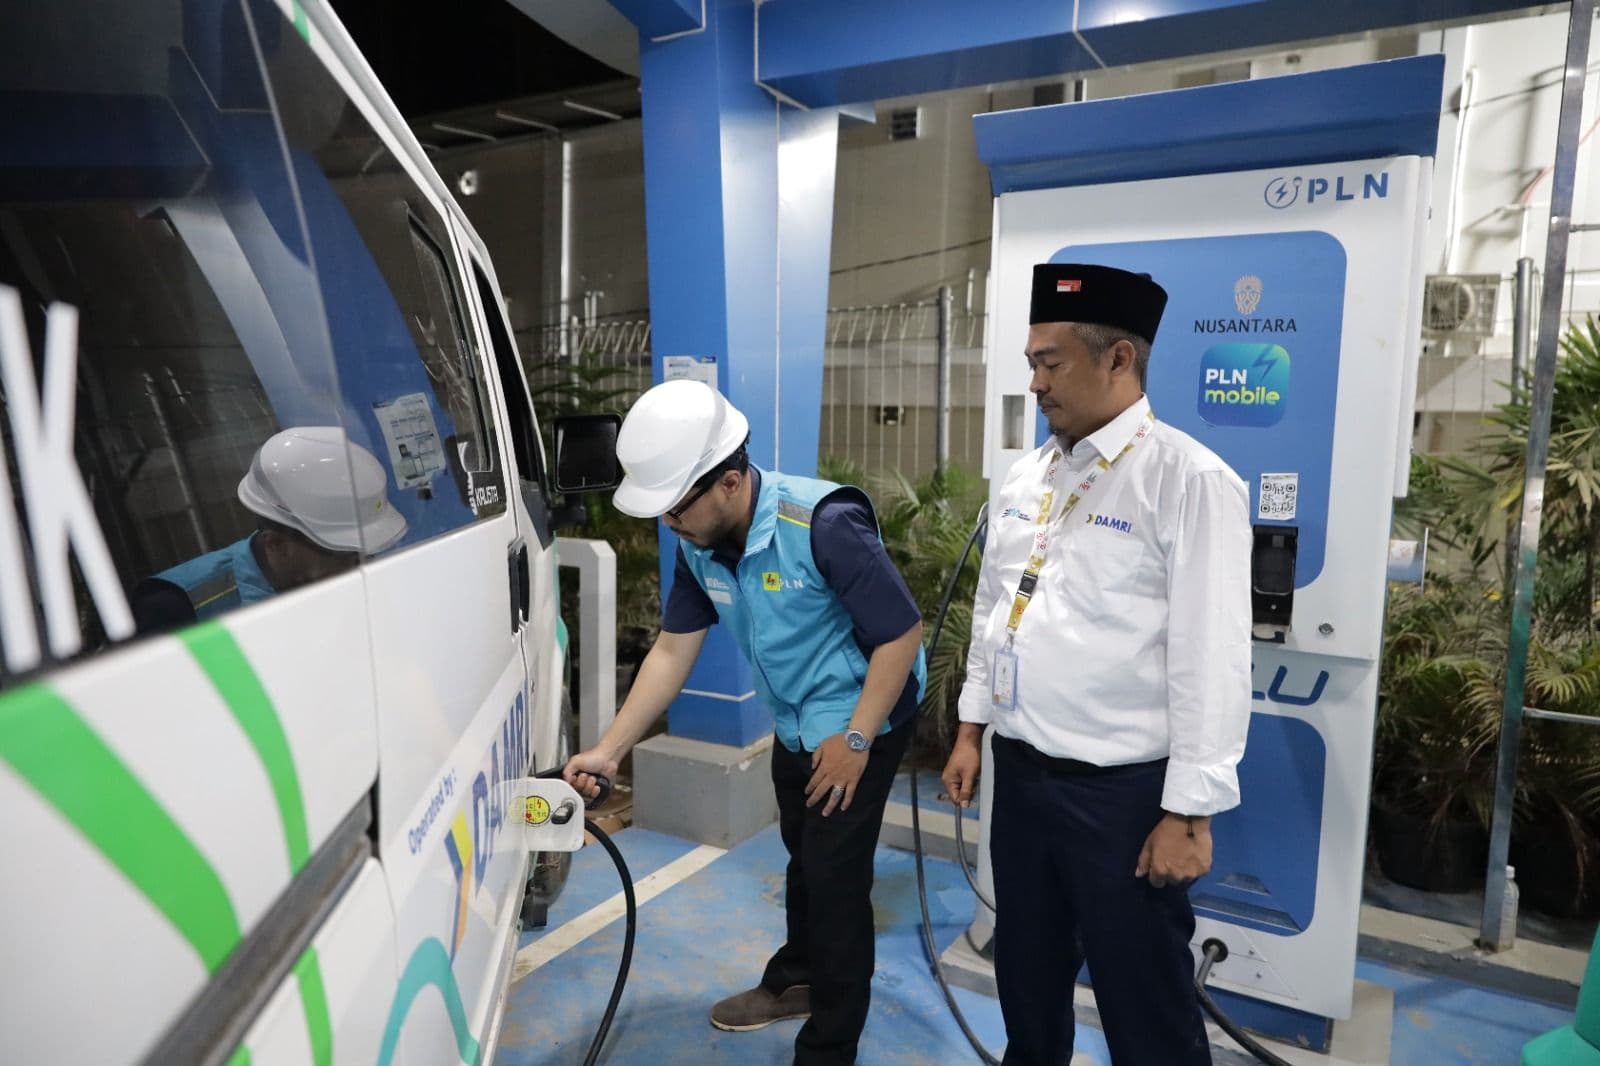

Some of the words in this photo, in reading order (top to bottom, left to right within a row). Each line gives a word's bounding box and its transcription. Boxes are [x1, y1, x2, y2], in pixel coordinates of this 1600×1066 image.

[1307, 172, 1389, 203] PLN
[1194, 318, 1297, 334] NUSANTARA
[1205, 368, 1247, 385] PLN
[1204, 386, 1280, 406] mobile
[1094, 513, 1132, 534] DAMRI
[472, 674, 530, 899] DAMRI
[408, 781, 445, 855] Operated
